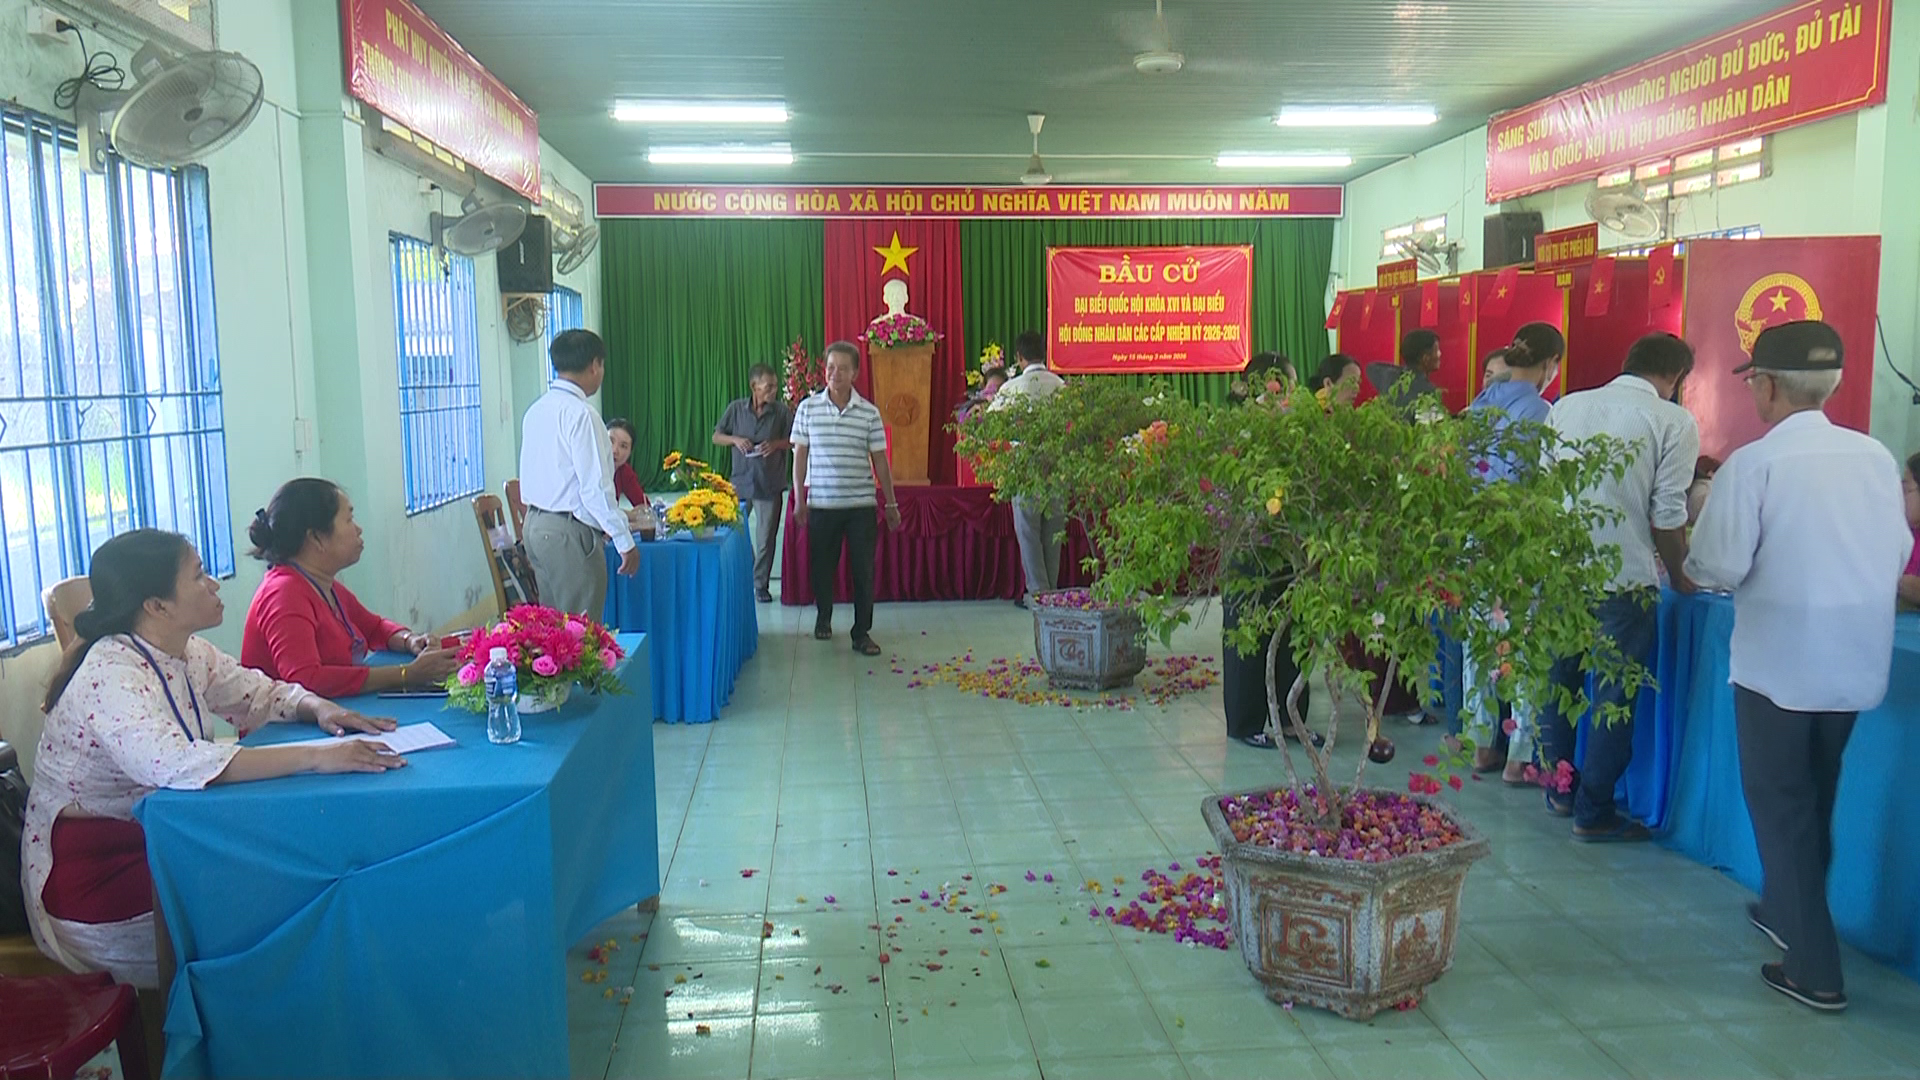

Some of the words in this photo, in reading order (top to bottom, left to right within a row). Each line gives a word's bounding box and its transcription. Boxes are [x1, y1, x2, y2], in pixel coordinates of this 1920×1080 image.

[385, 7, 409, 54] PHÁT
[411, 28, 427, 69] HUY
[361, 39, 394, 91] THÔNG
[1497, 127, 1524, 153] SÁNG
[1527, 110, 1554, 143] SUỐT
[1618, 77, 1666, 114] NHỮNG
[1669, 54, 1717, 98] NGƯỜI
[1721, 39, 1744, 80] ĐỦ
[1748, 32, 1789, 71] ĐỨC,
[1796, 10, 1823, 55] ĐỦ
[1829, 3, 1862, 43] TÀI
[1552, 136, 1583, 170] QUỐC
[1610, 127, 1625, 153] VÀ
[1629, 121, 1652, 150] HỘI
[1656, 104, 1697, 138] ĐỒNG
[1701, 88, 1748, 127] NHÂN
[1751, 75, 1791, 112] DÂN
[653, 189, 717, 211] NƯỚC
[724, 189, 788, 214] CỘNG
[794, 189, 841, 211] HÒA
[848, 189, 880, 211] XÃ
[885, 190, 923, 215] HỘI
[930, 187, 975, 212] CHỦ
[982, 189, 1050, 212] NGHĨA
[1057, 189, 1104, 214] VIỆT
[1109, 193, 1160, 211] NAM
[1167, 189, 1233, 211] MUÔN
[1239, 189, 1290, 211] NĂM
[1099, 254, 1153, 283] BẦU
[1163, 256, 1200, 283] CỬ
[1075, 297, 1088, 317] ĐẠI
[1089, 291, 1107, 313] BIỂU
[1108, 291, 1129, 315] QUỐC
[1130, 293, 1144, 316] HỘI
[1145, 292, 1166, 313] KHÓA
[1167, 296, 1180, 313] XVI
[1181, 292, 1192, 313] VÀ
[1192, 296, 1206, 316] ĐẠI
[1207, 290, 1225, 313] BIỂU
[1058, 322, 1071, 346] HỘI
[1073, 320, 1093, 343] ĐỒNG
[1095, 322, 1116, 343] NHÂN
[1117, 322, 1133, 343] DÂN
[1134, 322, 1149, 342] CÁC
[1150, 319, 1166, 342] CẤP
[1167, 321, 1191, 345] NHIỆM
[1203, 324, 1240, 342] 2026-2031
[1112, 354, 1128, 362] Ngày
[1136, 353, 1154, 362] tháng
